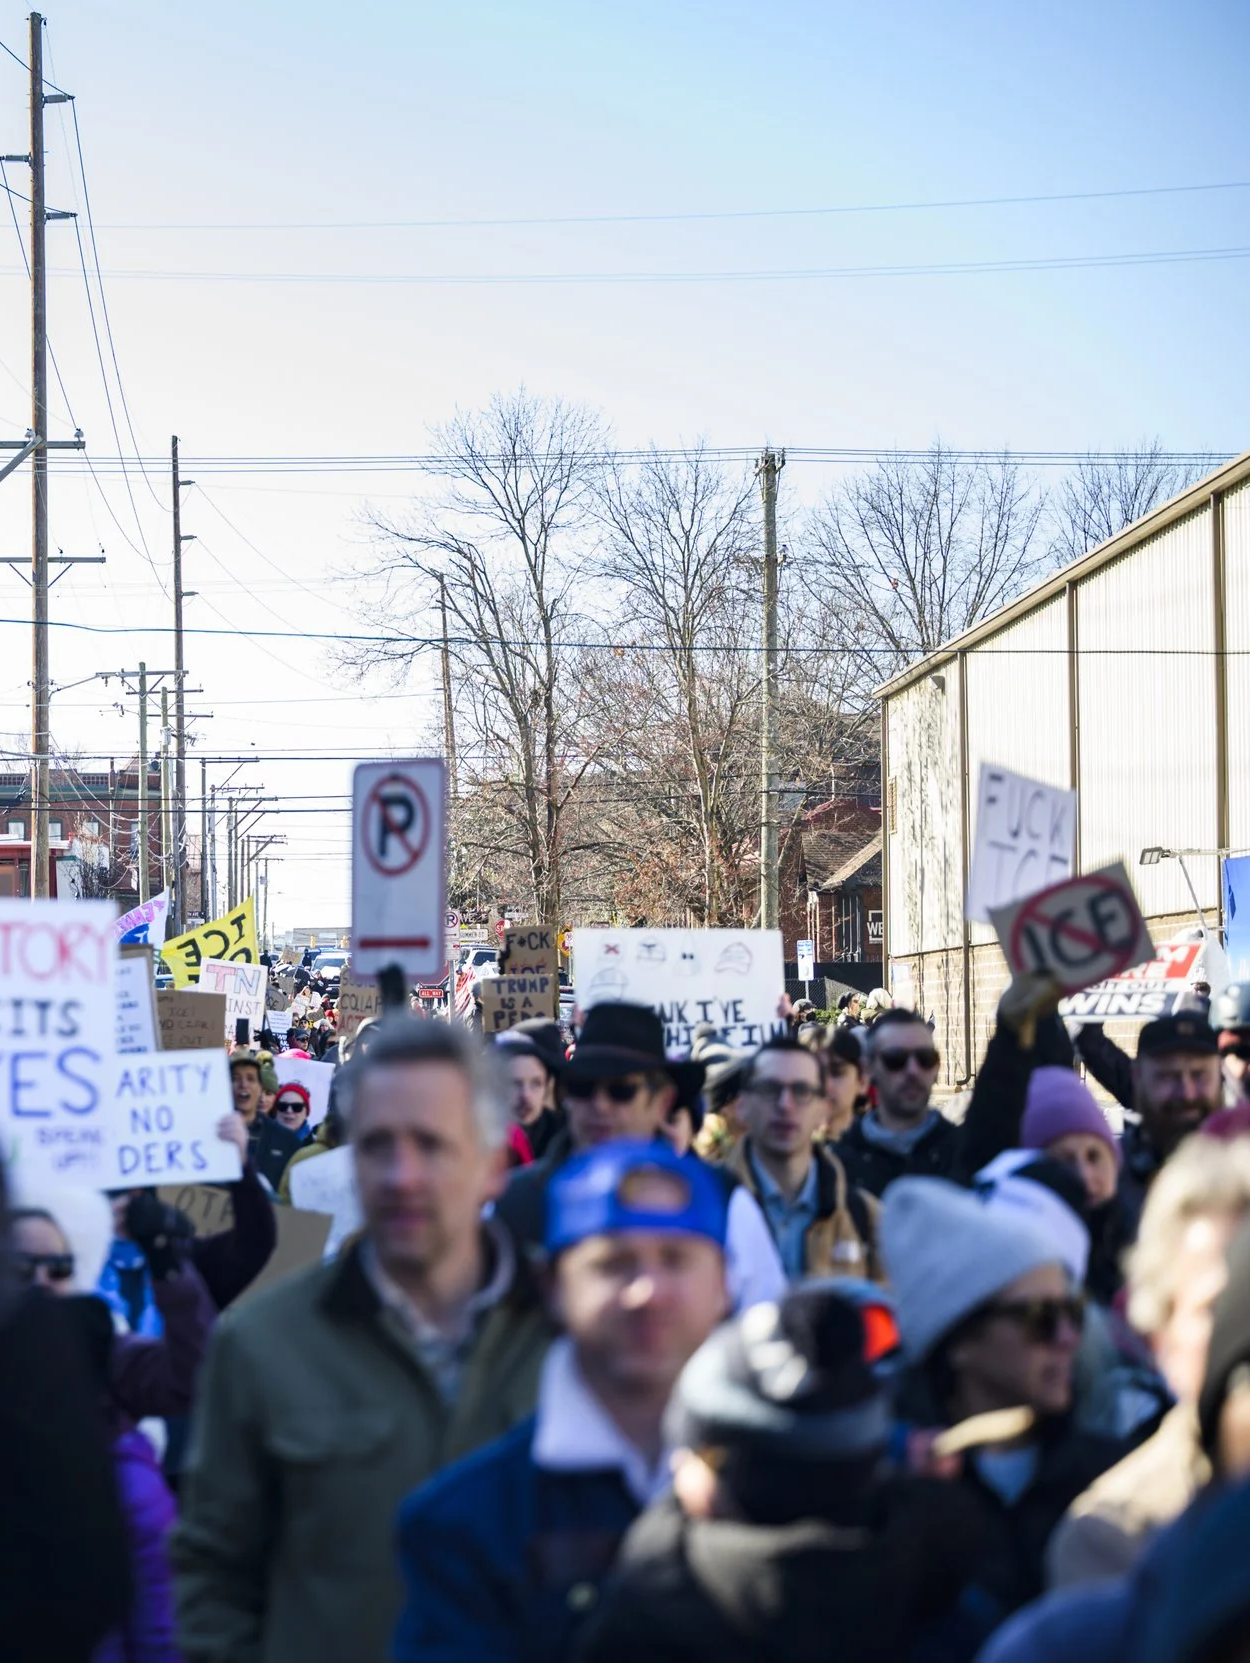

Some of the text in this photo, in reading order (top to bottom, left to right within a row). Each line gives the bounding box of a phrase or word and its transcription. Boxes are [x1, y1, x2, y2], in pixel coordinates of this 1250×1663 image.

[983, 772, 1068, 848] FUCK
[1020, 885, 1136, 970] ICE
[206, 964, 262, 997] TN
[491, 977, 550, 995] TRUMP
[8, 998, 83, 1038] ITS
[501, 996, 533, 1010] IS A
[1058, 991, 1166, 1016] WINS
[116, 1063, 211, 1098] ARITY
[130, 1104, 174, 1135] NO
[118, 1139, 208, 1175] DERS
